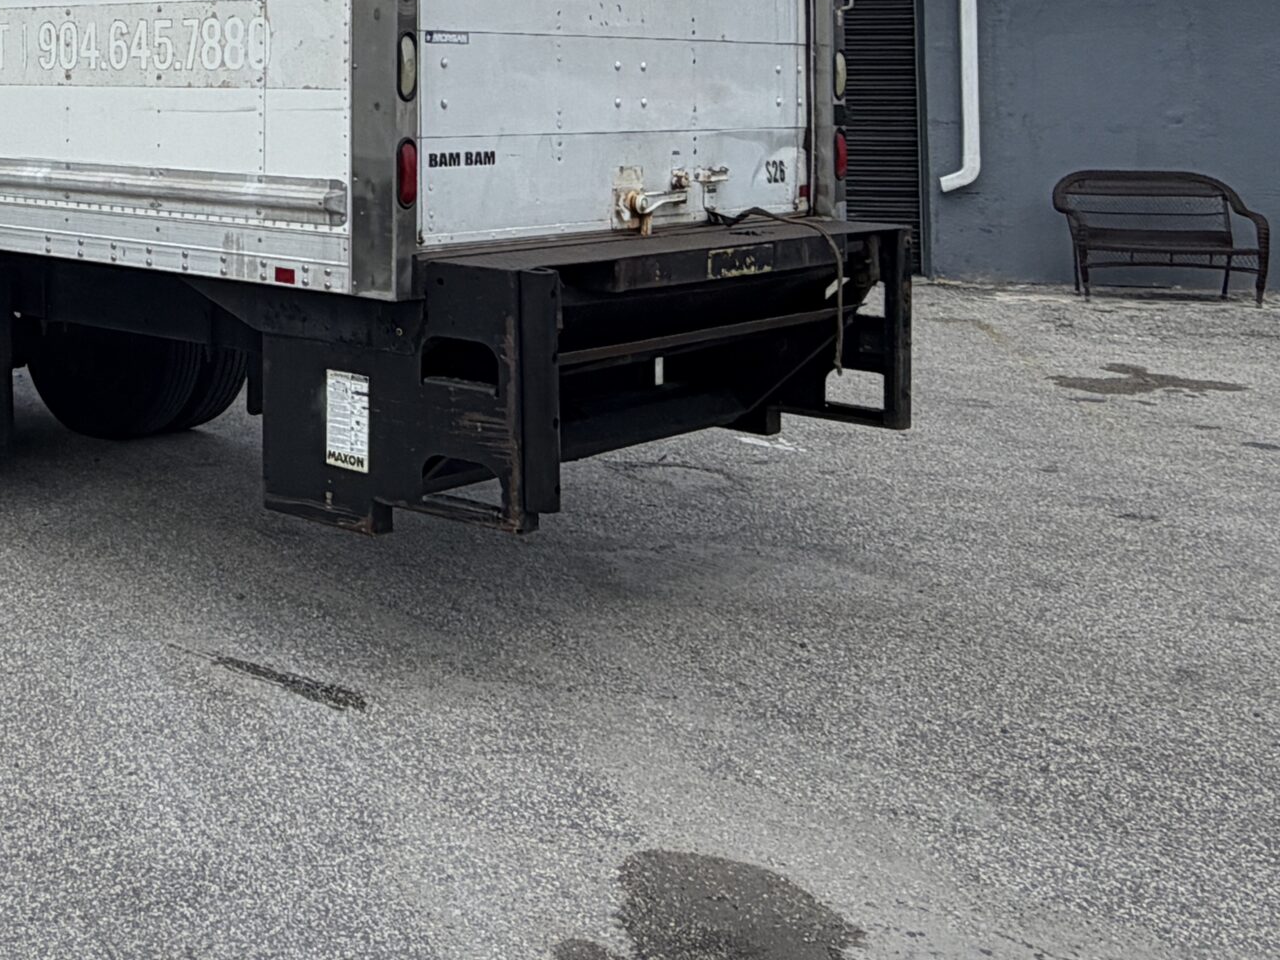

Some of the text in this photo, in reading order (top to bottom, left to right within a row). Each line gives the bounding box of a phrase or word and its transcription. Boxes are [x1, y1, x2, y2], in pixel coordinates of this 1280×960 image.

[38, 16, 271, 71] 904.645.7880
[429, 151, 496, 168] BAM BAM
[765, 159, 786, 184] S26
[327, 451, 365, 468] MAXON
